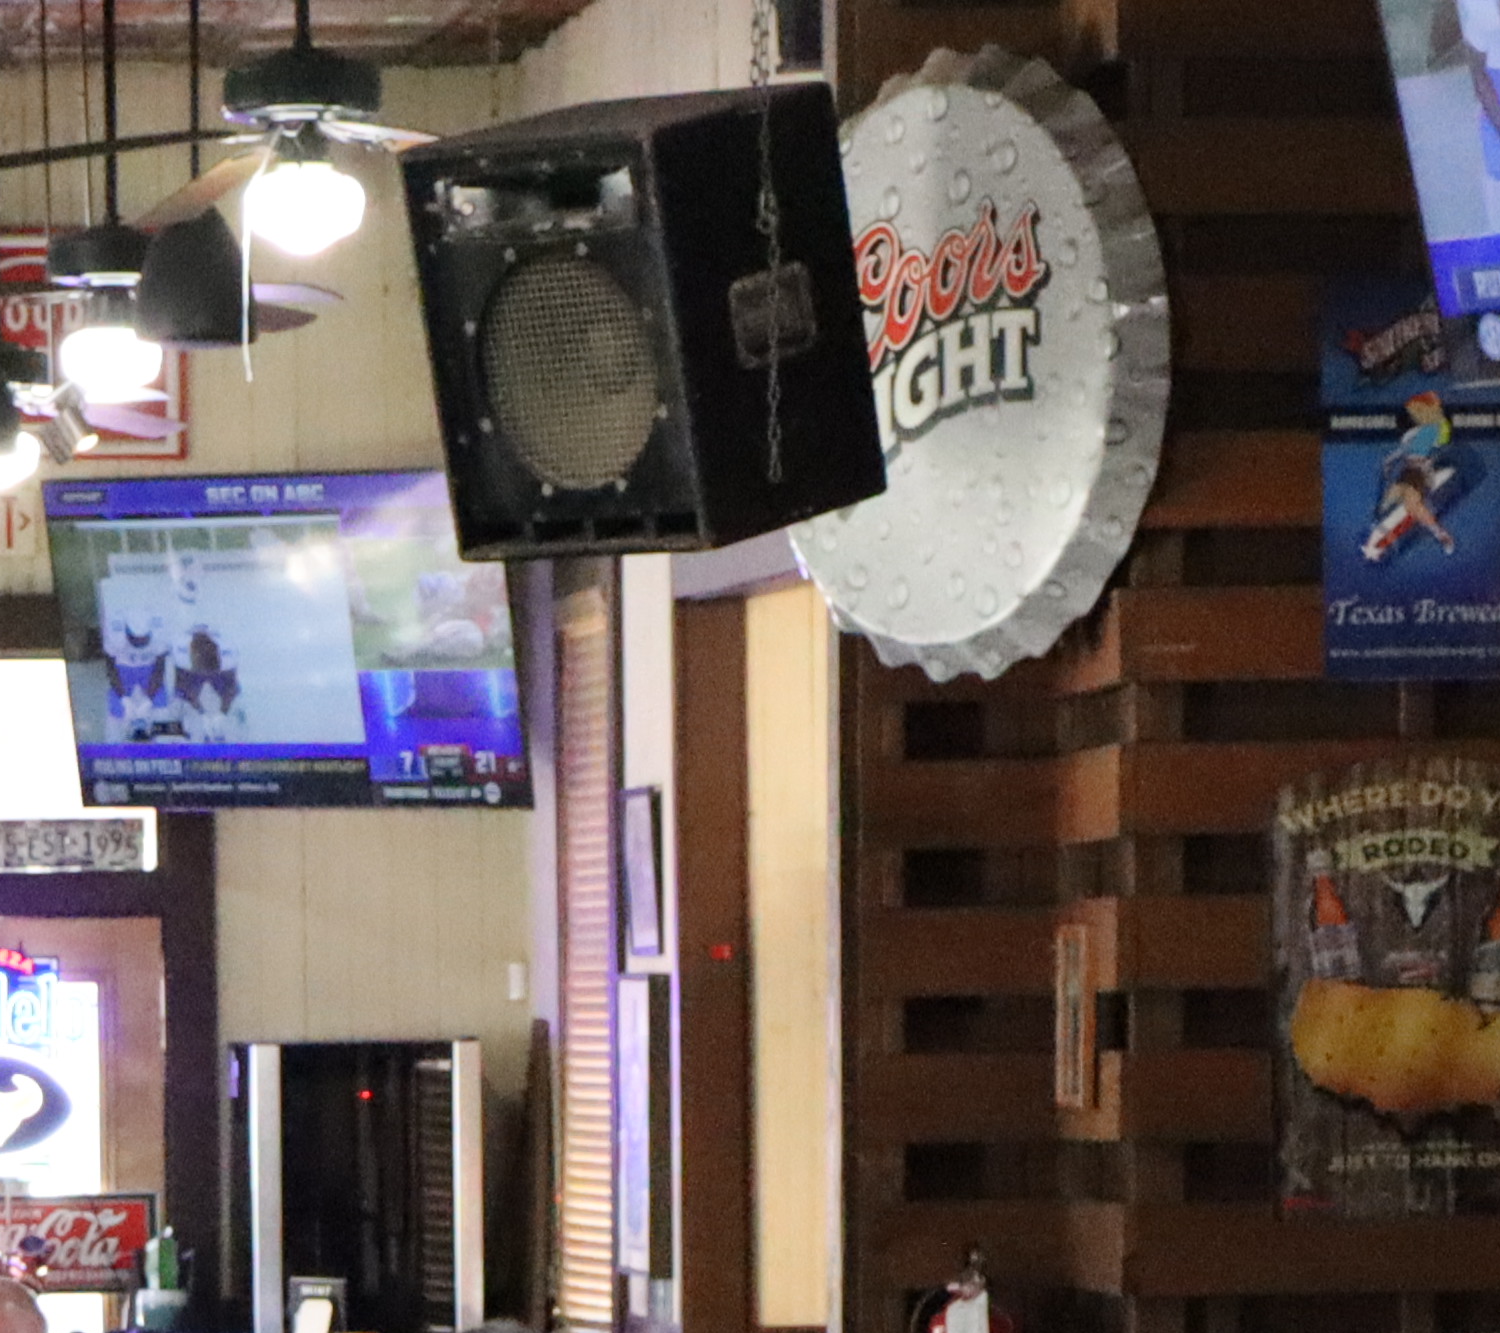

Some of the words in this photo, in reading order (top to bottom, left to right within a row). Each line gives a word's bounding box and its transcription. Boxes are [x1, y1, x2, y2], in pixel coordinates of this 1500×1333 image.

[873, 307, 1040, 459] IGHT
[1328, 594, 1405, 626] Texas
[400, 750, 414, 777] 7
[474, 750, 498, 774] 21
[1277, 782, 1411, 837] WHERE
[1419, 781, 1473, 809] DO
[1361, 837, 1472, 862] RODEO
